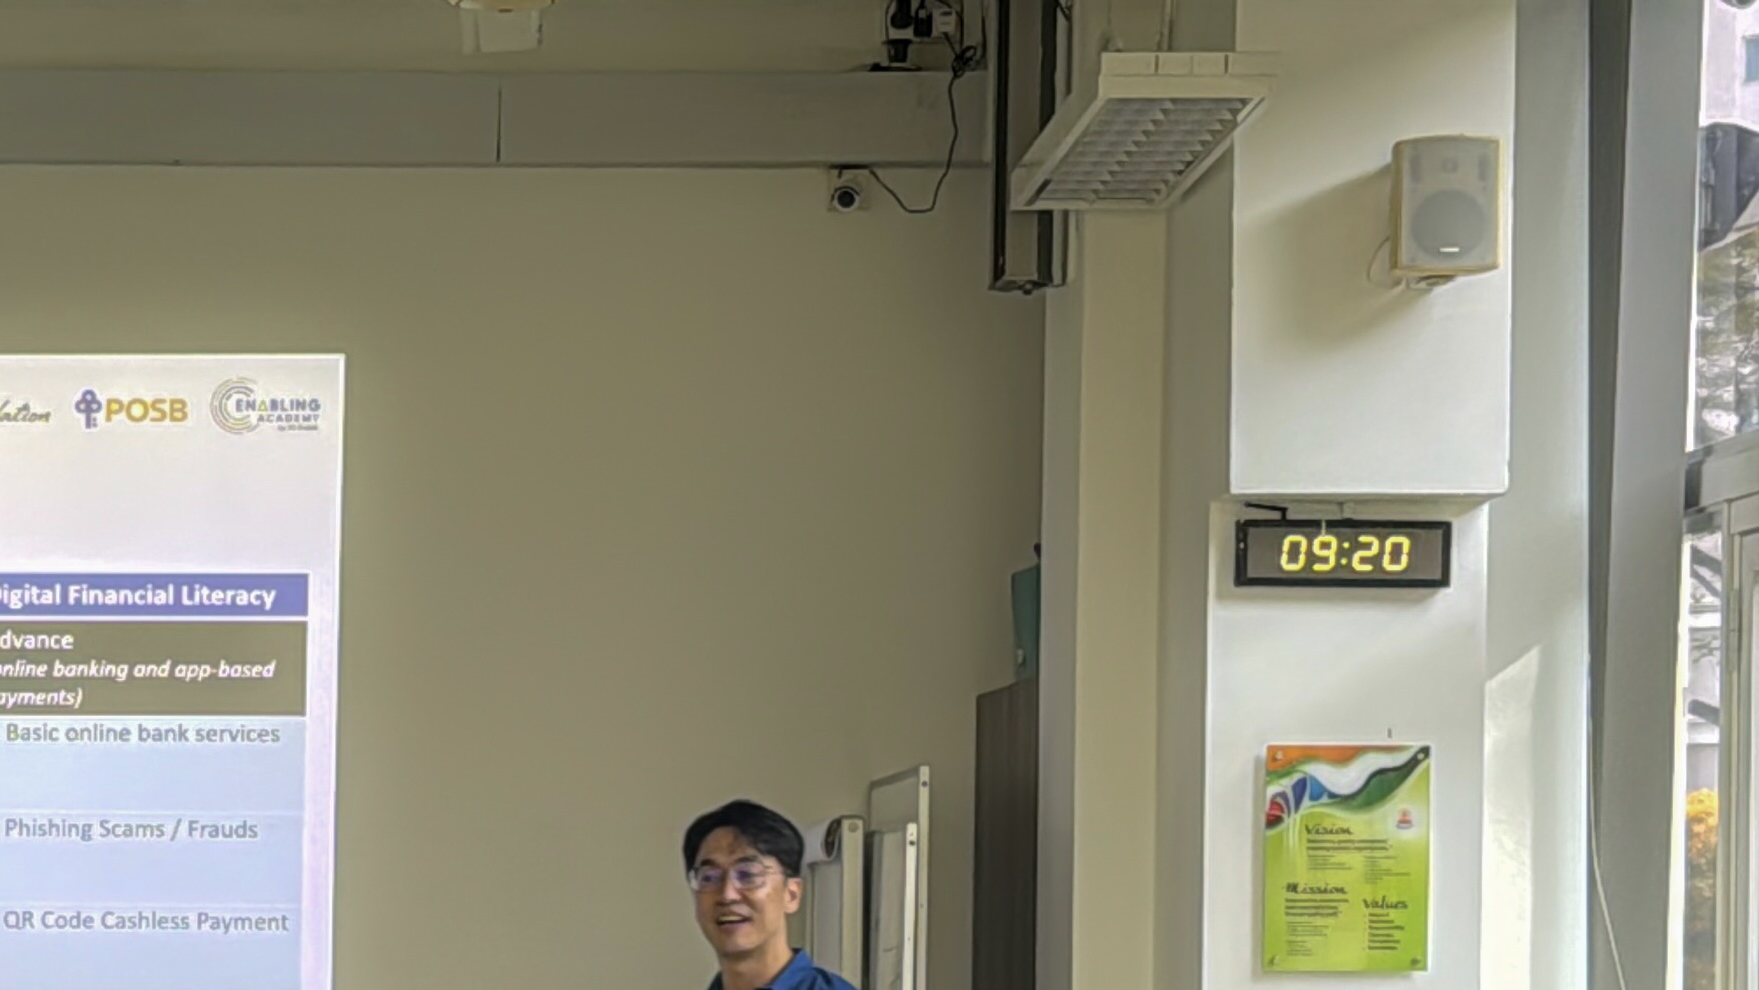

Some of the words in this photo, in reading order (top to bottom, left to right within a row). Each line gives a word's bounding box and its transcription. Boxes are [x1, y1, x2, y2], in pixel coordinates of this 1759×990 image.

[105, 397, 188, 424] POSB
[235, 397, 321, 414] ENABLING
[257, 414, 321, 424] ACADEMY
[1280, 534, 1411, 573] 09:20
[68, 584, 174, 607] Financial
[181, 584, 276, 609] Literacy
[52, 659, 128, 681] banking
[133, 659, 170, 679] and
[174, 660, 275, 682] app-based
[5, 723, 60, 744] Basic
[64, 723, 132, 744] online
[138, 723, 189, 744] bank
[195, 724, 281, 744] services
[3, 818, 94, 845] Phishing
[99, 819, 165, 840] Scams
[169, 819, 182, 842] /
[187, 819, 259, 840] Frauds
[1305, 823, 1353, 836] Vision
[1285, 882, 1348, 894] Mission
[1362, 895, 1409, 910] Values
[3, 911, 36, 934] QR
[40, 911, 95, 932] Code
[100, 910, 191, 932] Cashless
[196, 911, 290, 936] Payment
